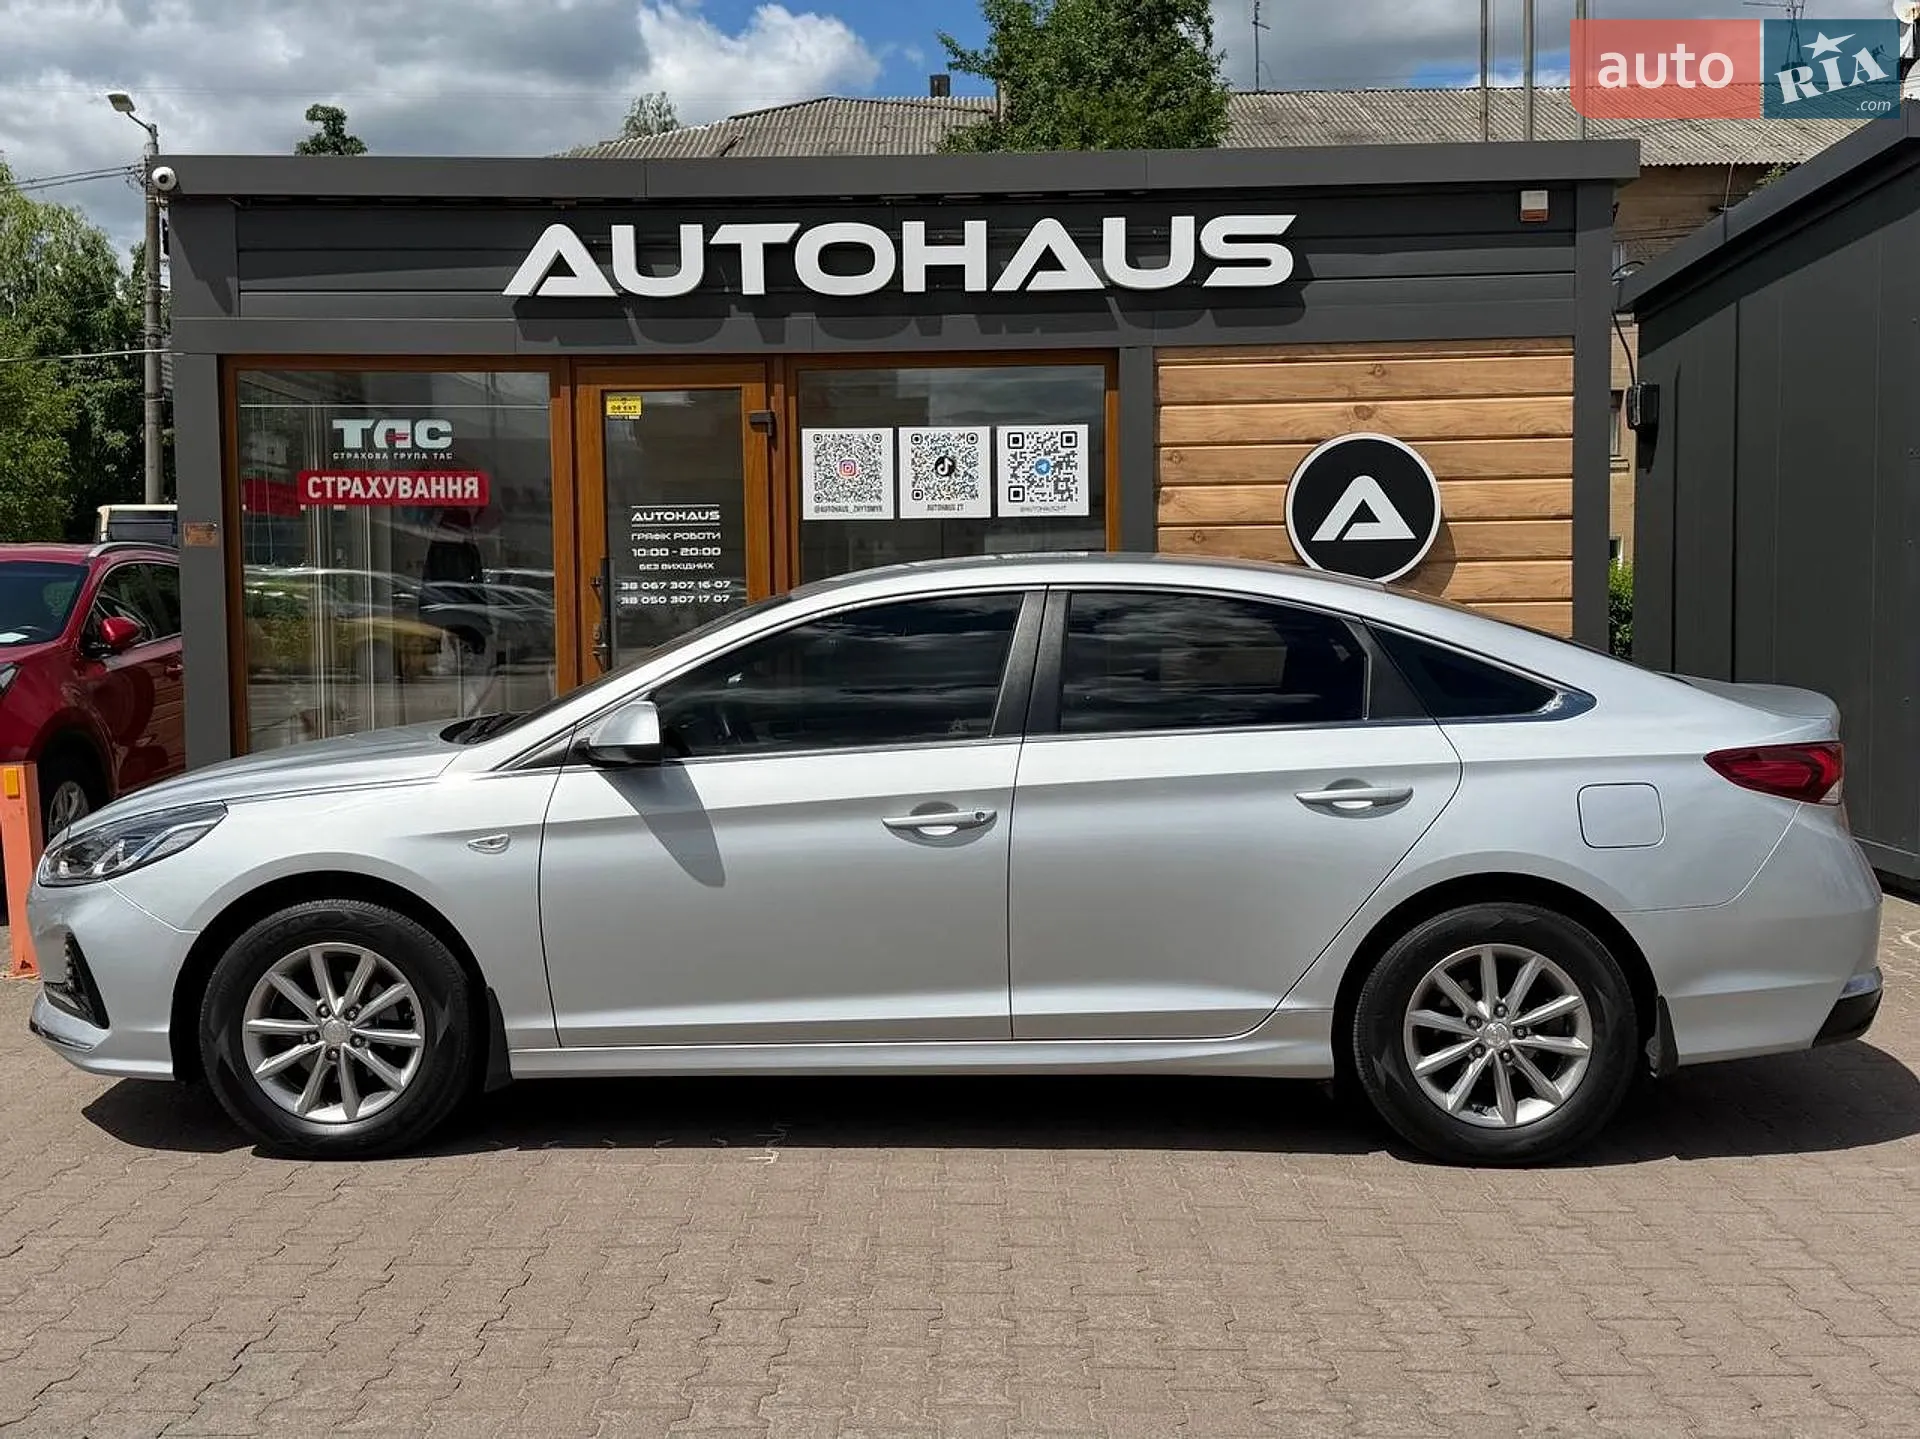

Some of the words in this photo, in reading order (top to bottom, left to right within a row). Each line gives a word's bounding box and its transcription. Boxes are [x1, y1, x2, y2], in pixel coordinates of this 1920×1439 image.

[503, 214, 1297, 298] AUTOHAUS
[332, 452, 389, 460] СТРАХОВА
[393, 452, 428, 460] ГРУПА
[433, 452, 453, 460] ТАС
[307, 476, 479, 499] СТРАХУВАННЯ
[631, 511, 720, 521] AUTOHAUS
[631, 532, 672, 541] ГРАФІК
[673, 532, 721, 540] РОБОТИ
[632, 547, 670, 557] 10:00
[680, 547, 721, 556] 20:00
[639, 563, 660, 571] БЕЗ
[641, 581, 667, 590] 067
[669, 581, 695, 590] 307
[713, 580, 731, 589] 07
[640, 596, 667, 604] 050
[669, 595, 695, 604] 307
[698, 594, 711, 603] 17
[713, 594, 730, 603] 07
